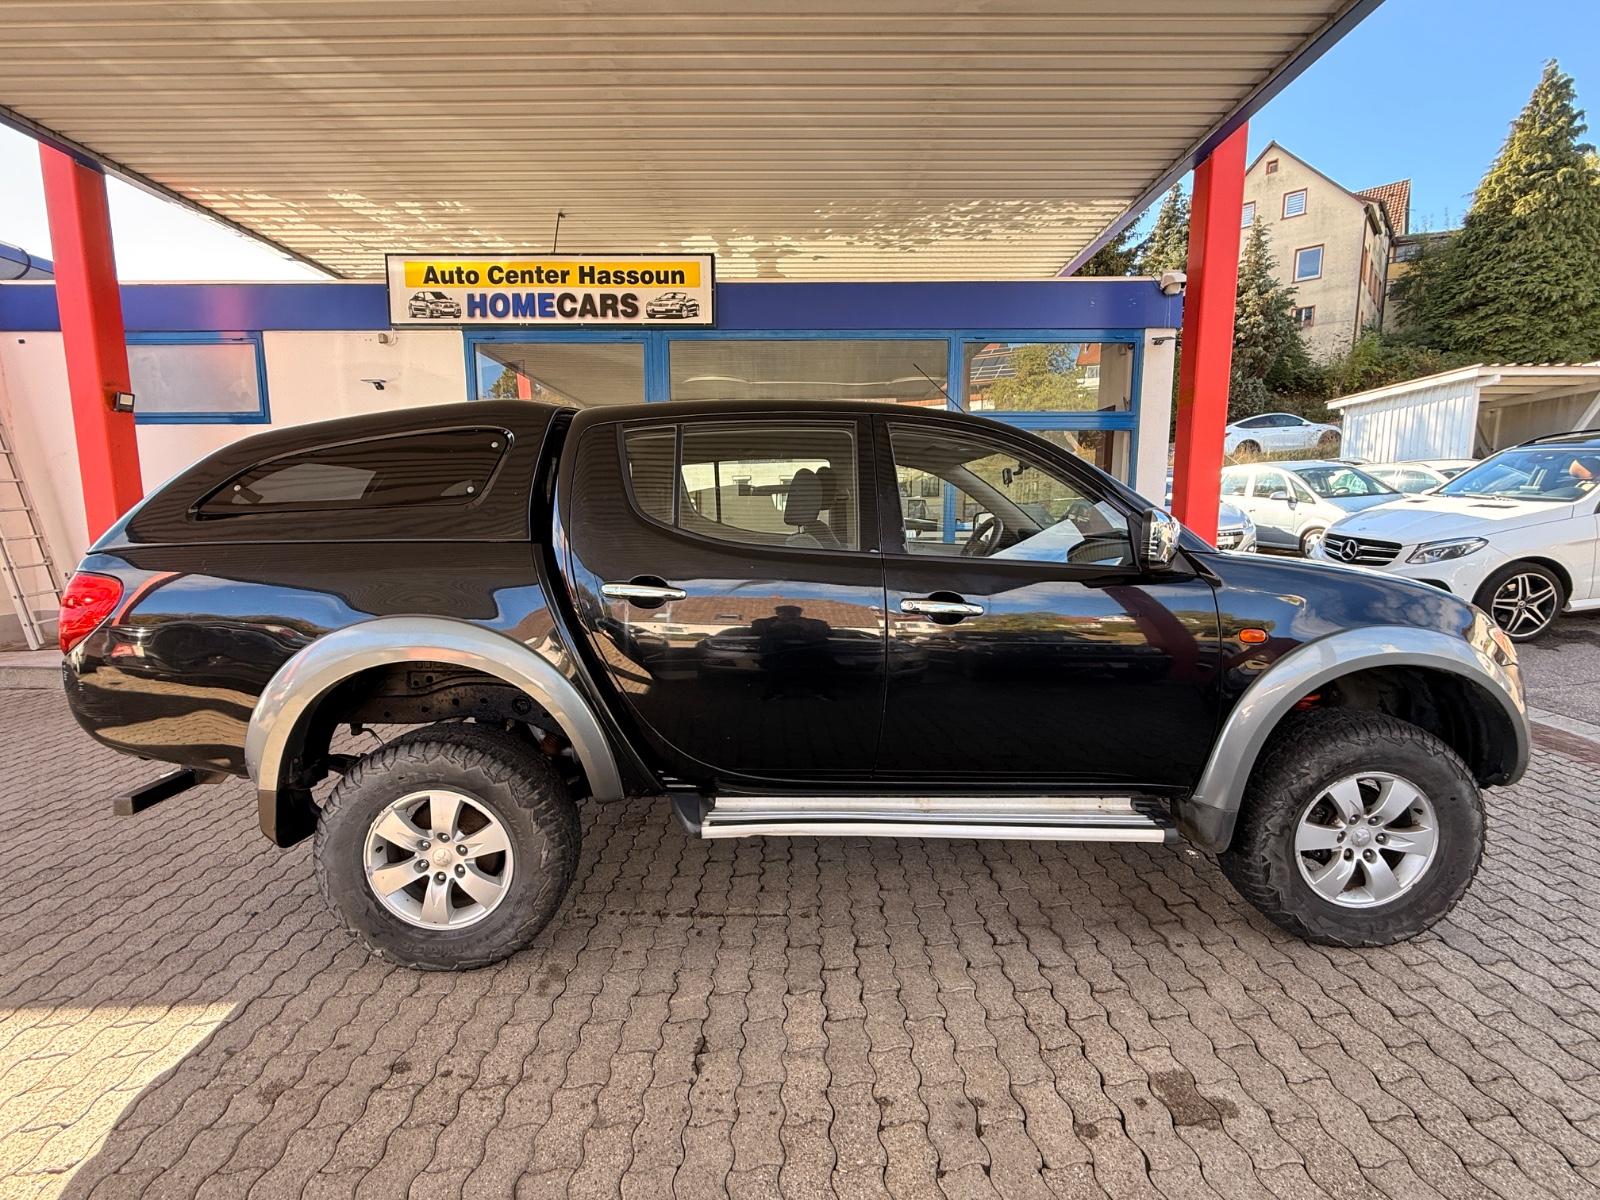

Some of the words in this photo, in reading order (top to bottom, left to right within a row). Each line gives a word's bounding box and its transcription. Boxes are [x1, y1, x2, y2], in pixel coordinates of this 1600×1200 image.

[423, 265, 480, 285] Auto
[487, 265, 571, 285] Center
[578, 265, 685, 285] Hassoun
[466, 292, 639, 319] HOMECARS
